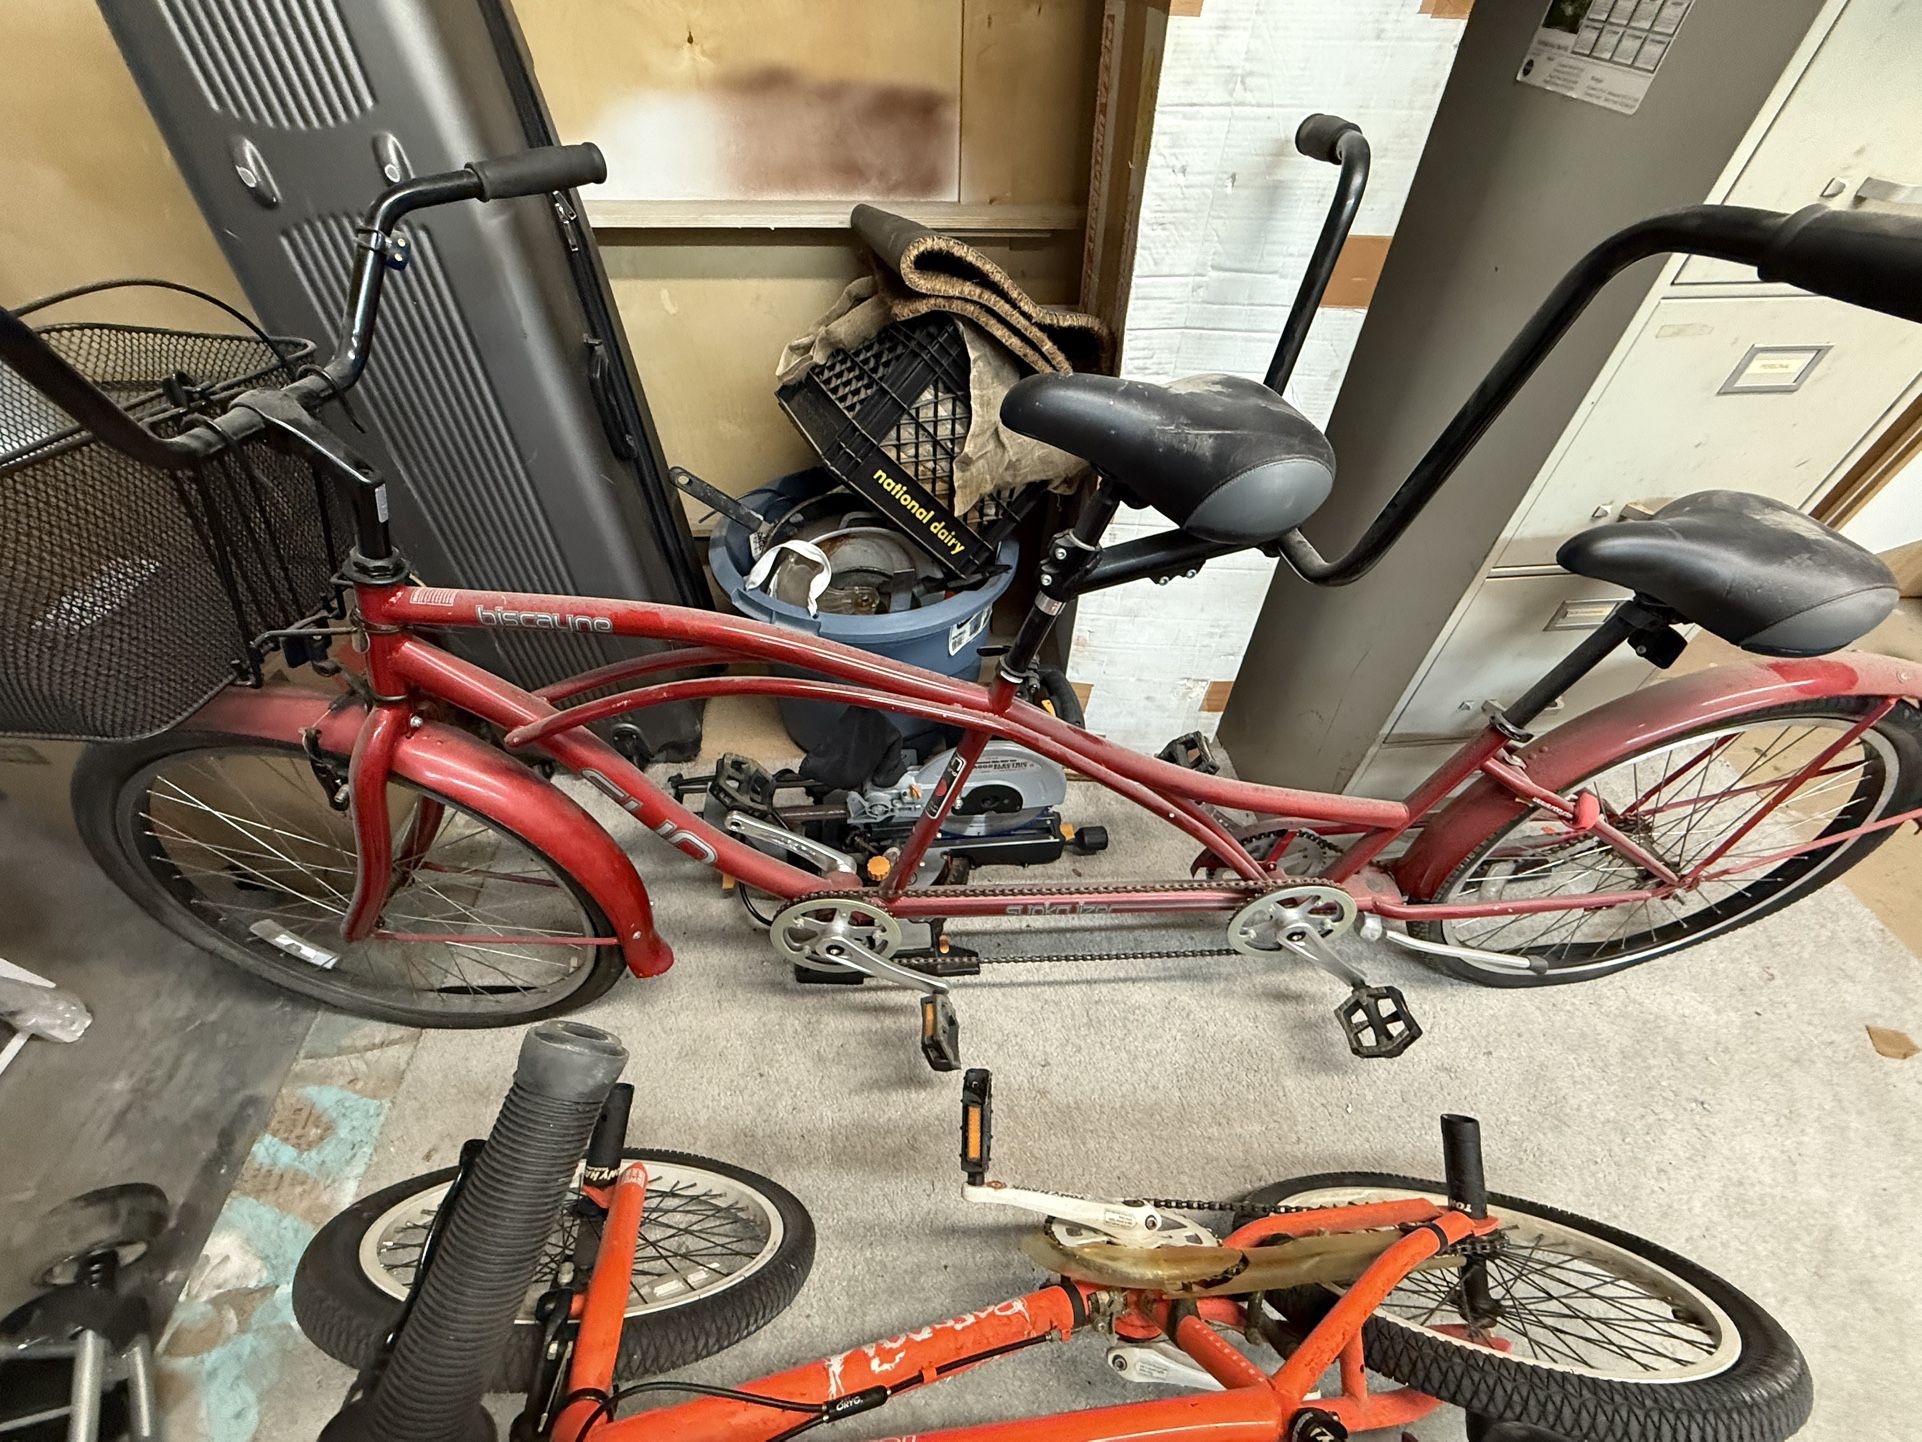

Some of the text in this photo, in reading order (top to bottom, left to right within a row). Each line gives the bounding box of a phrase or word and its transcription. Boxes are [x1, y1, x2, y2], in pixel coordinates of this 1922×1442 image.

[873, 469, 965, 555] national dairy
[475, 605, 614, 633] biscayne
